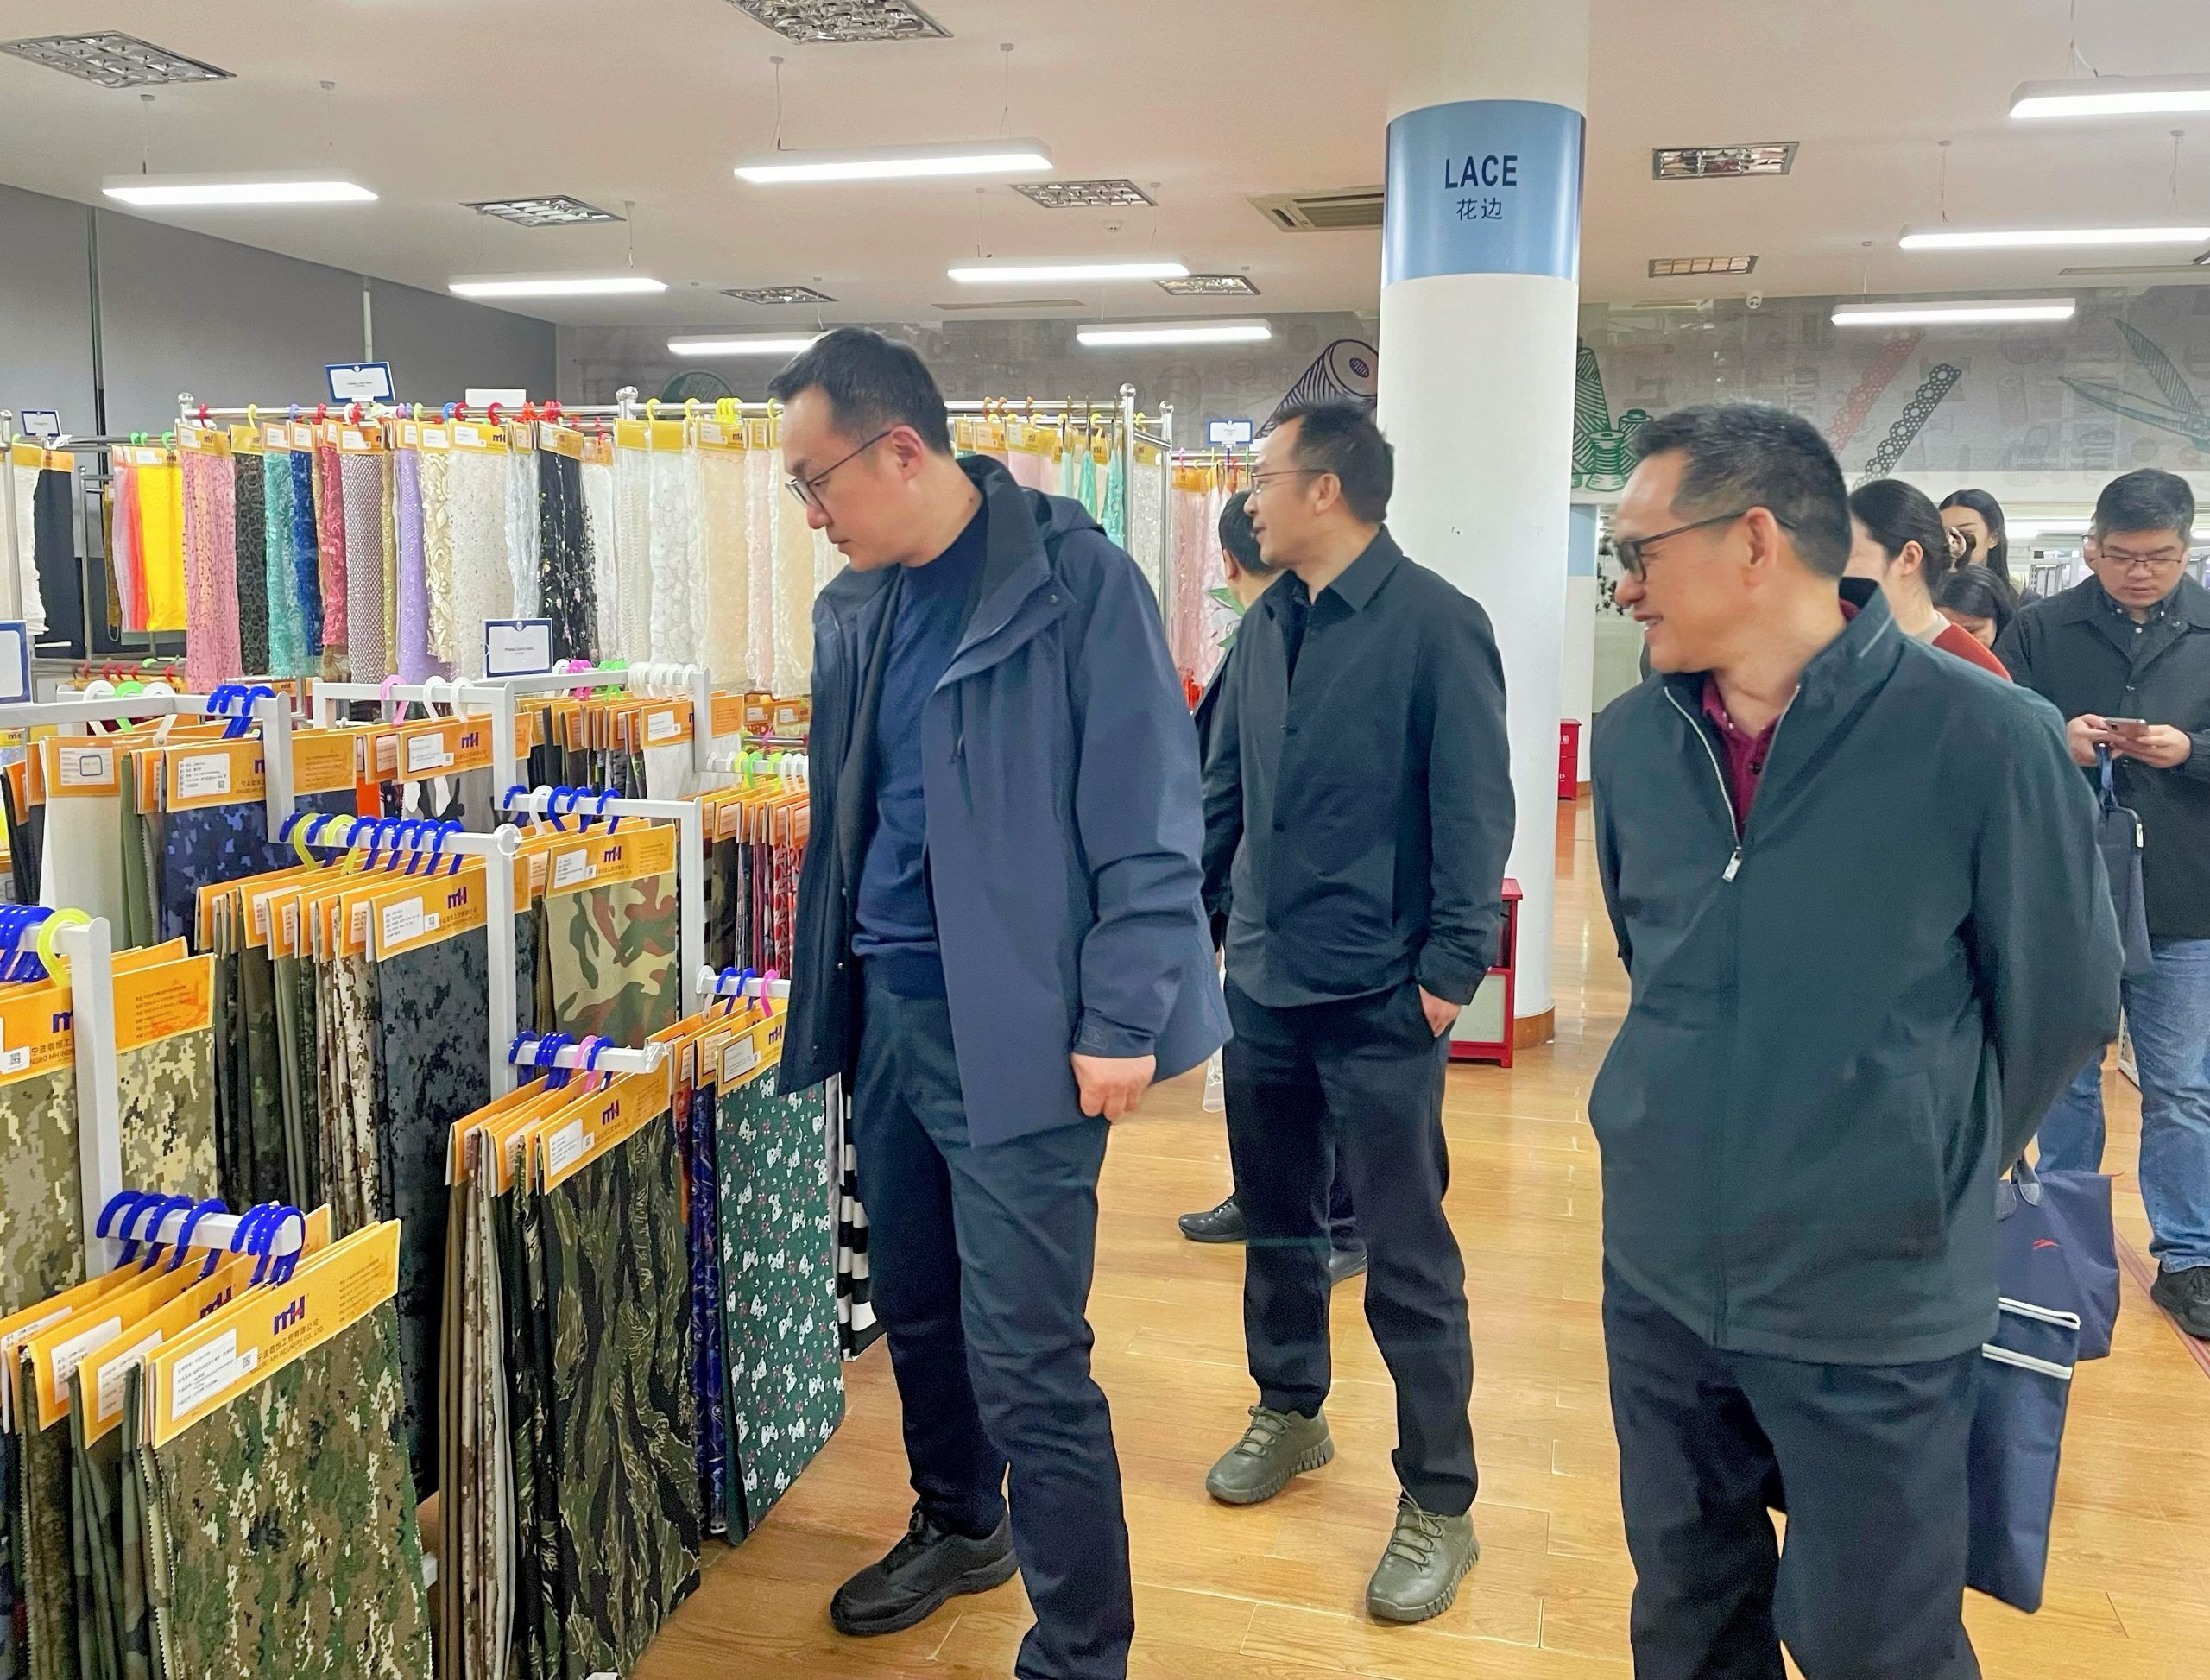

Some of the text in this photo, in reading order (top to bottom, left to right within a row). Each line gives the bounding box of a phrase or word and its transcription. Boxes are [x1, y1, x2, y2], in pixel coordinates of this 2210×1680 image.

[1444, 155, 1518, 189] LACE
[1456, 197, 1503, 221] 花边
[273, 1294, 306, 1336] mH
